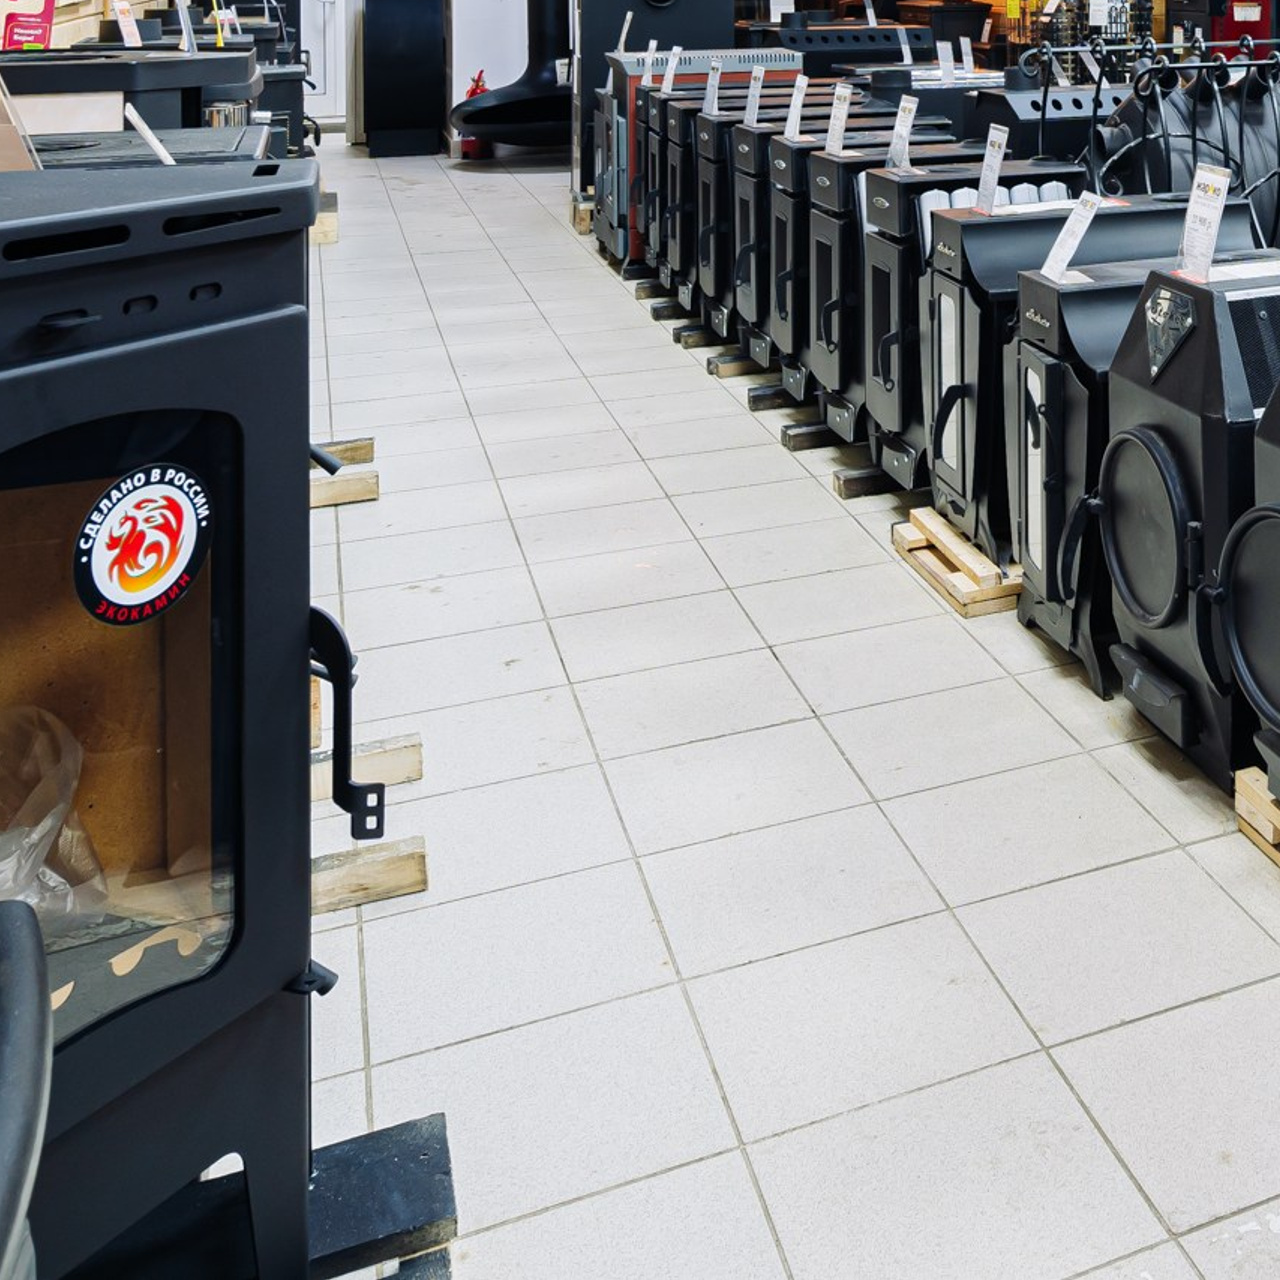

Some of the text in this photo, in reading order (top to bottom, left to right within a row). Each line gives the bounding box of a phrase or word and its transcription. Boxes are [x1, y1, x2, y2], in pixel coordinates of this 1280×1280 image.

[79, 469, 210, 550] СДЕЛАНО В РОССИИ
[96, 573, 191, 621] ЭКОКАМИН
